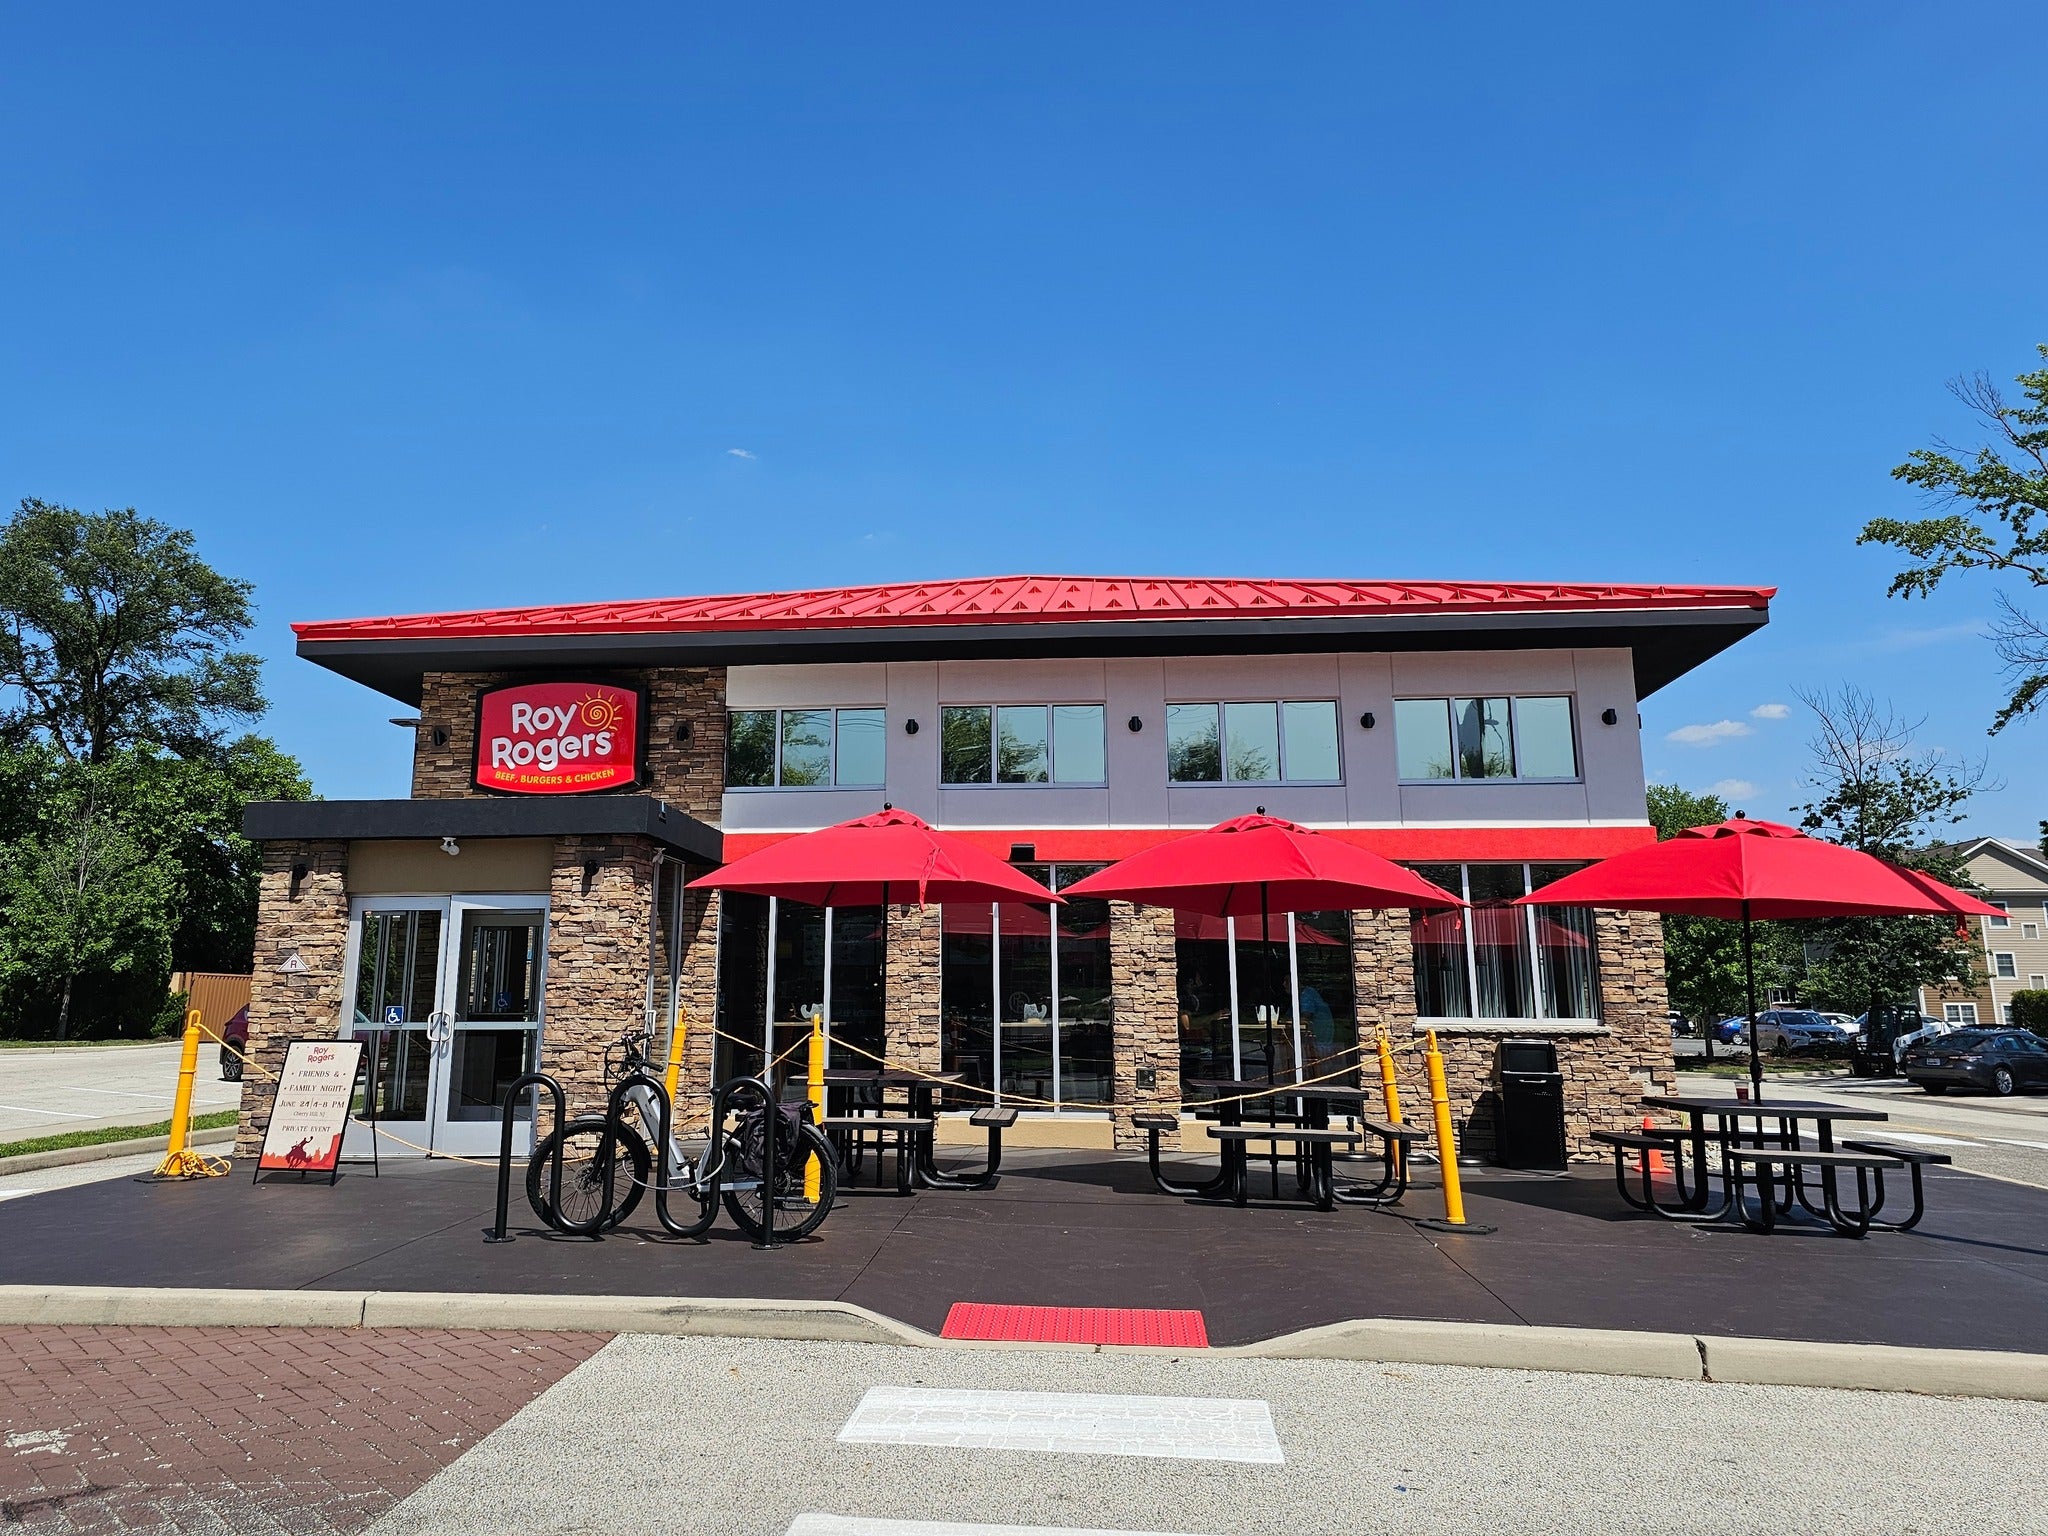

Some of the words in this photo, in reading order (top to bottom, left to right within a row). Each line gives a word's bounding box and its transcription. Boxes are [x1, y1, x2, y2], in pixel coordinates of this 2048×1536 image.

[511, 702, 577, 737] Roy
[491, 731, 612, 771] Rogers
[495, 770, 518, 783] BEEF,
[520, 774, 563, 784] BURGERS
[565, 775, 572, 783] &
[574, 768, 614, 783] CHICKEN
[313, 1046, 329, 1055] Roy
[307, 1054, 335, 1063] Rogers
[298, 1070, 331, 1078] FRIENDS
[289, 1084, 317, 1092] FAMILY
